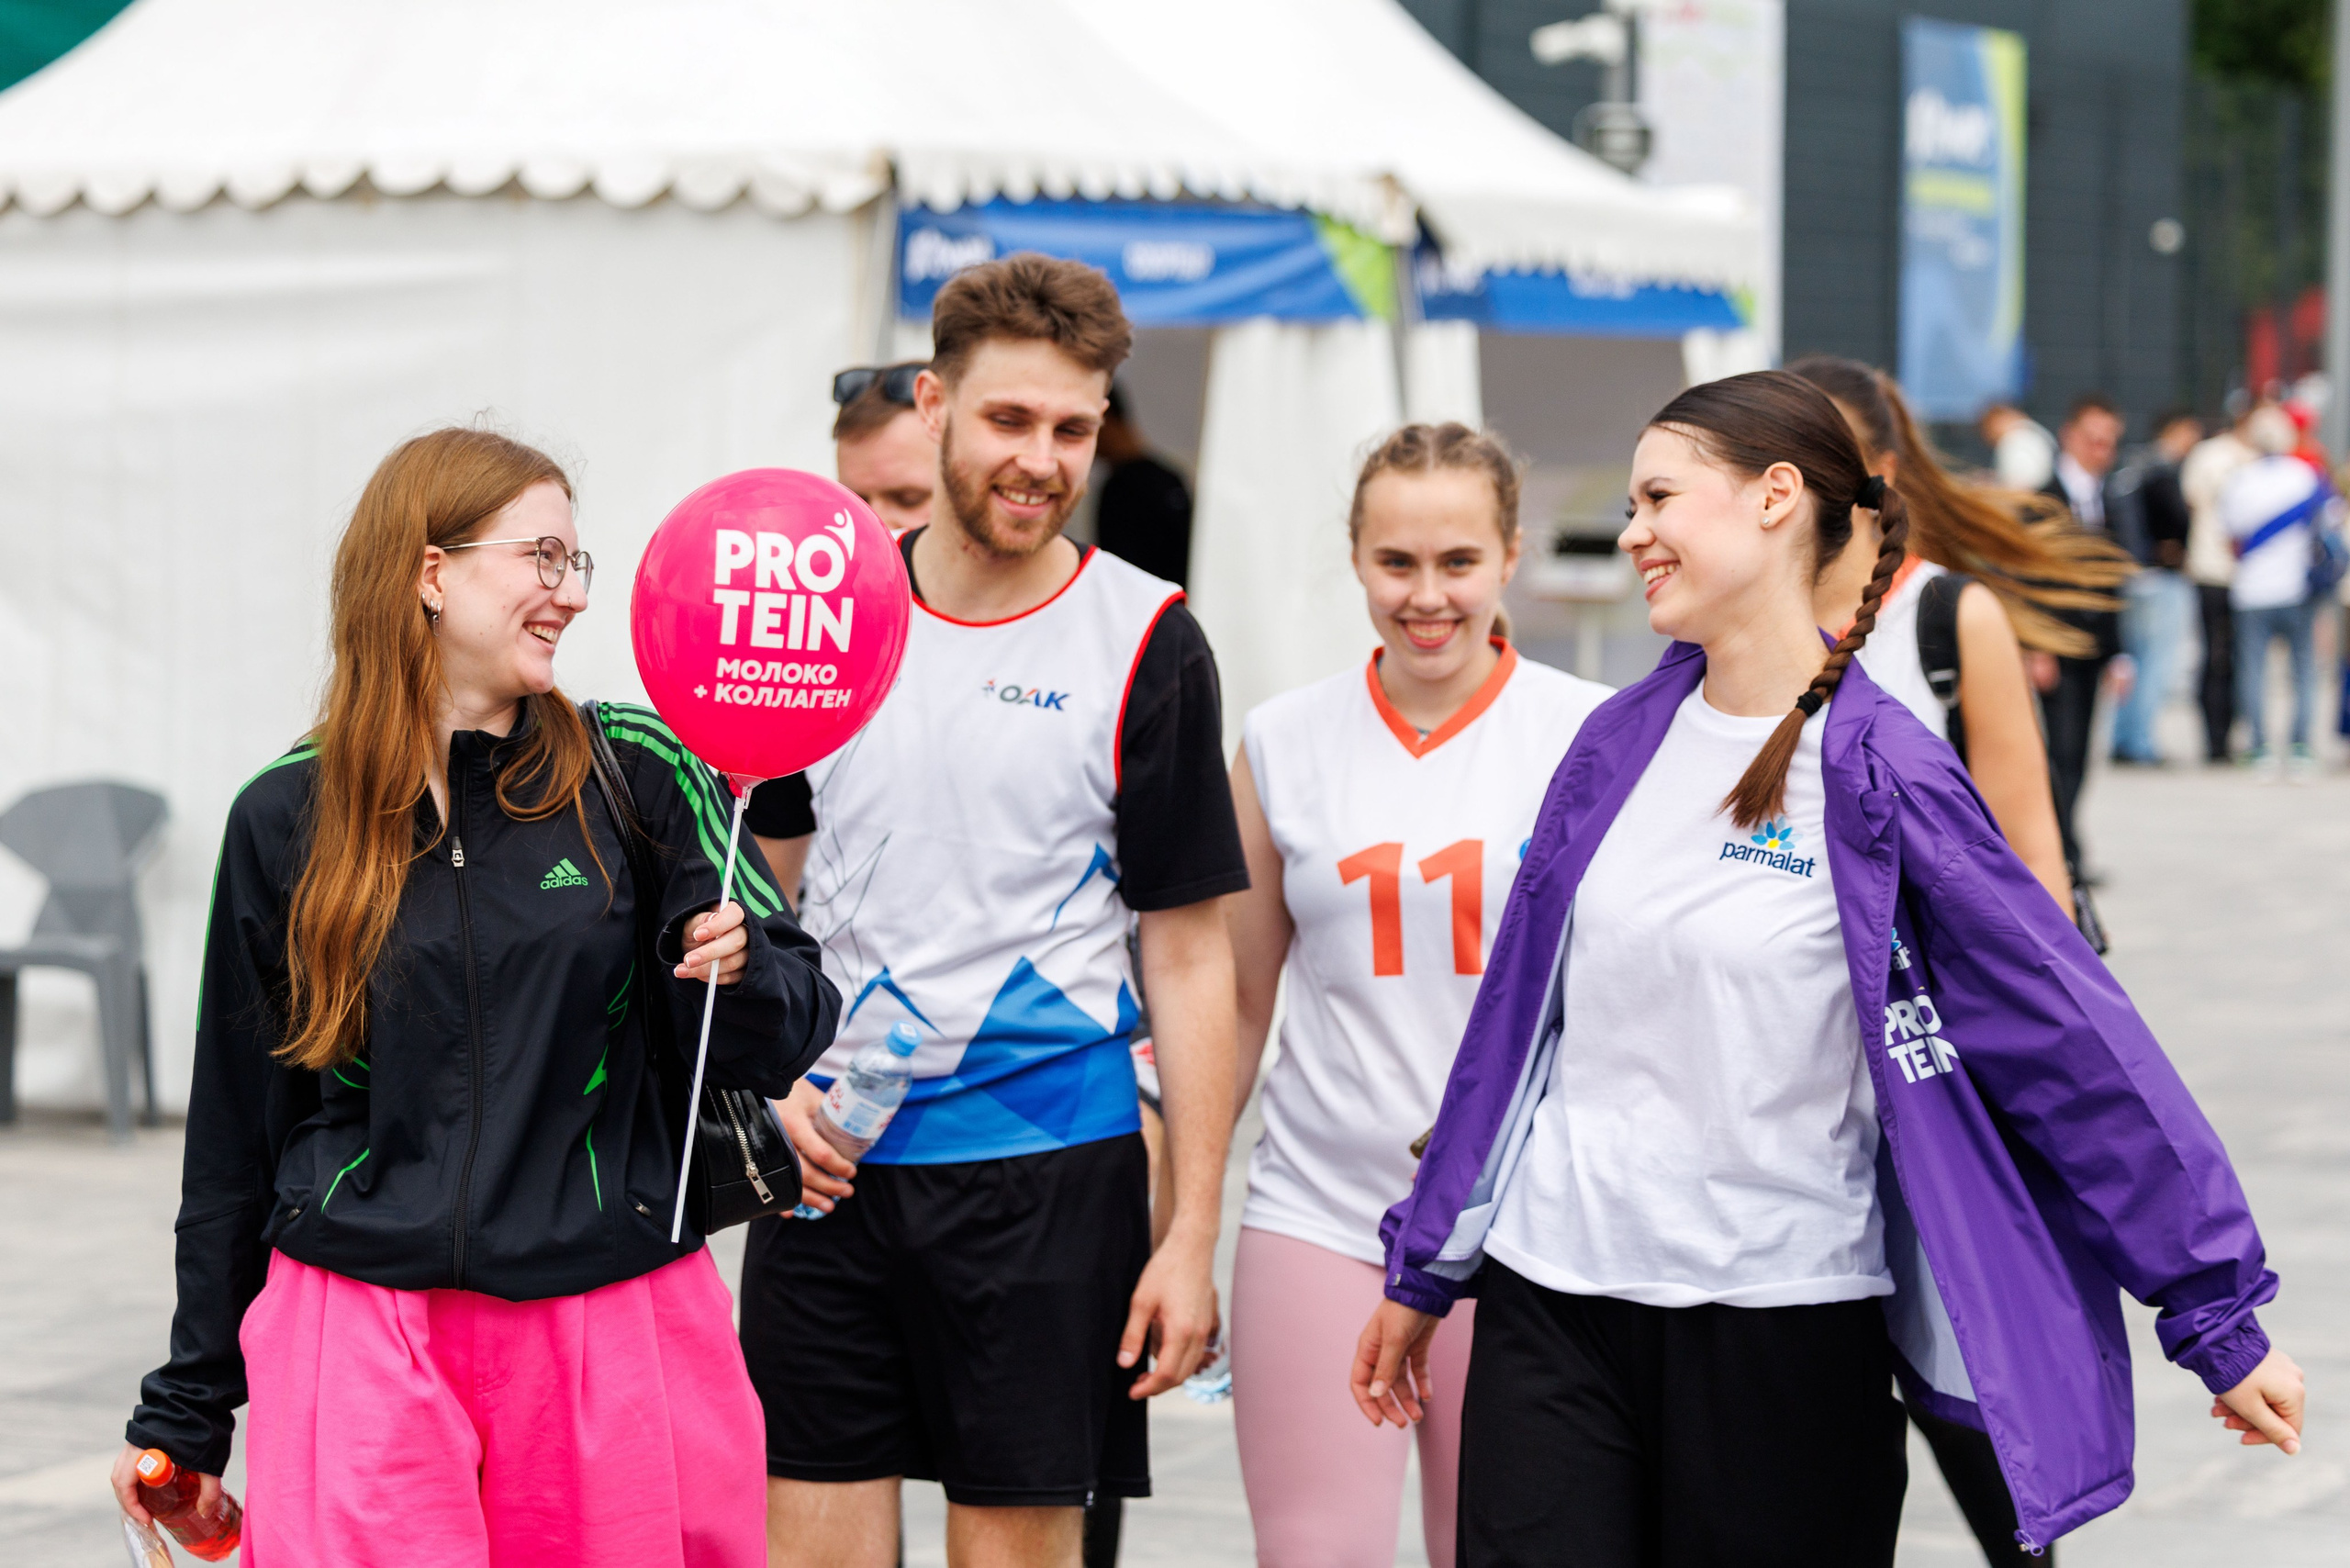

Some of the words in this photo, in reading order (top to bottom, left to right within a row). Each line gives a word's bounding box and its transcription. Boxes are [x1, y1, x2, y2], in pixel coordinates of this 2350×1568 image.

[714, 529, 845, 593] PRO
[713, 588, 854, 653] TEIN
[716, 657, 838, 685] МОЛОКО
[714, 683, 852, 709] КОЛЛАГЕН
[1719, 842, 1816, 878] parmalat
[540, 875, 588, 890] adidas
[1337, 839, 1484, 977] 11
[1885, 994, 1942, 1046] PRO
